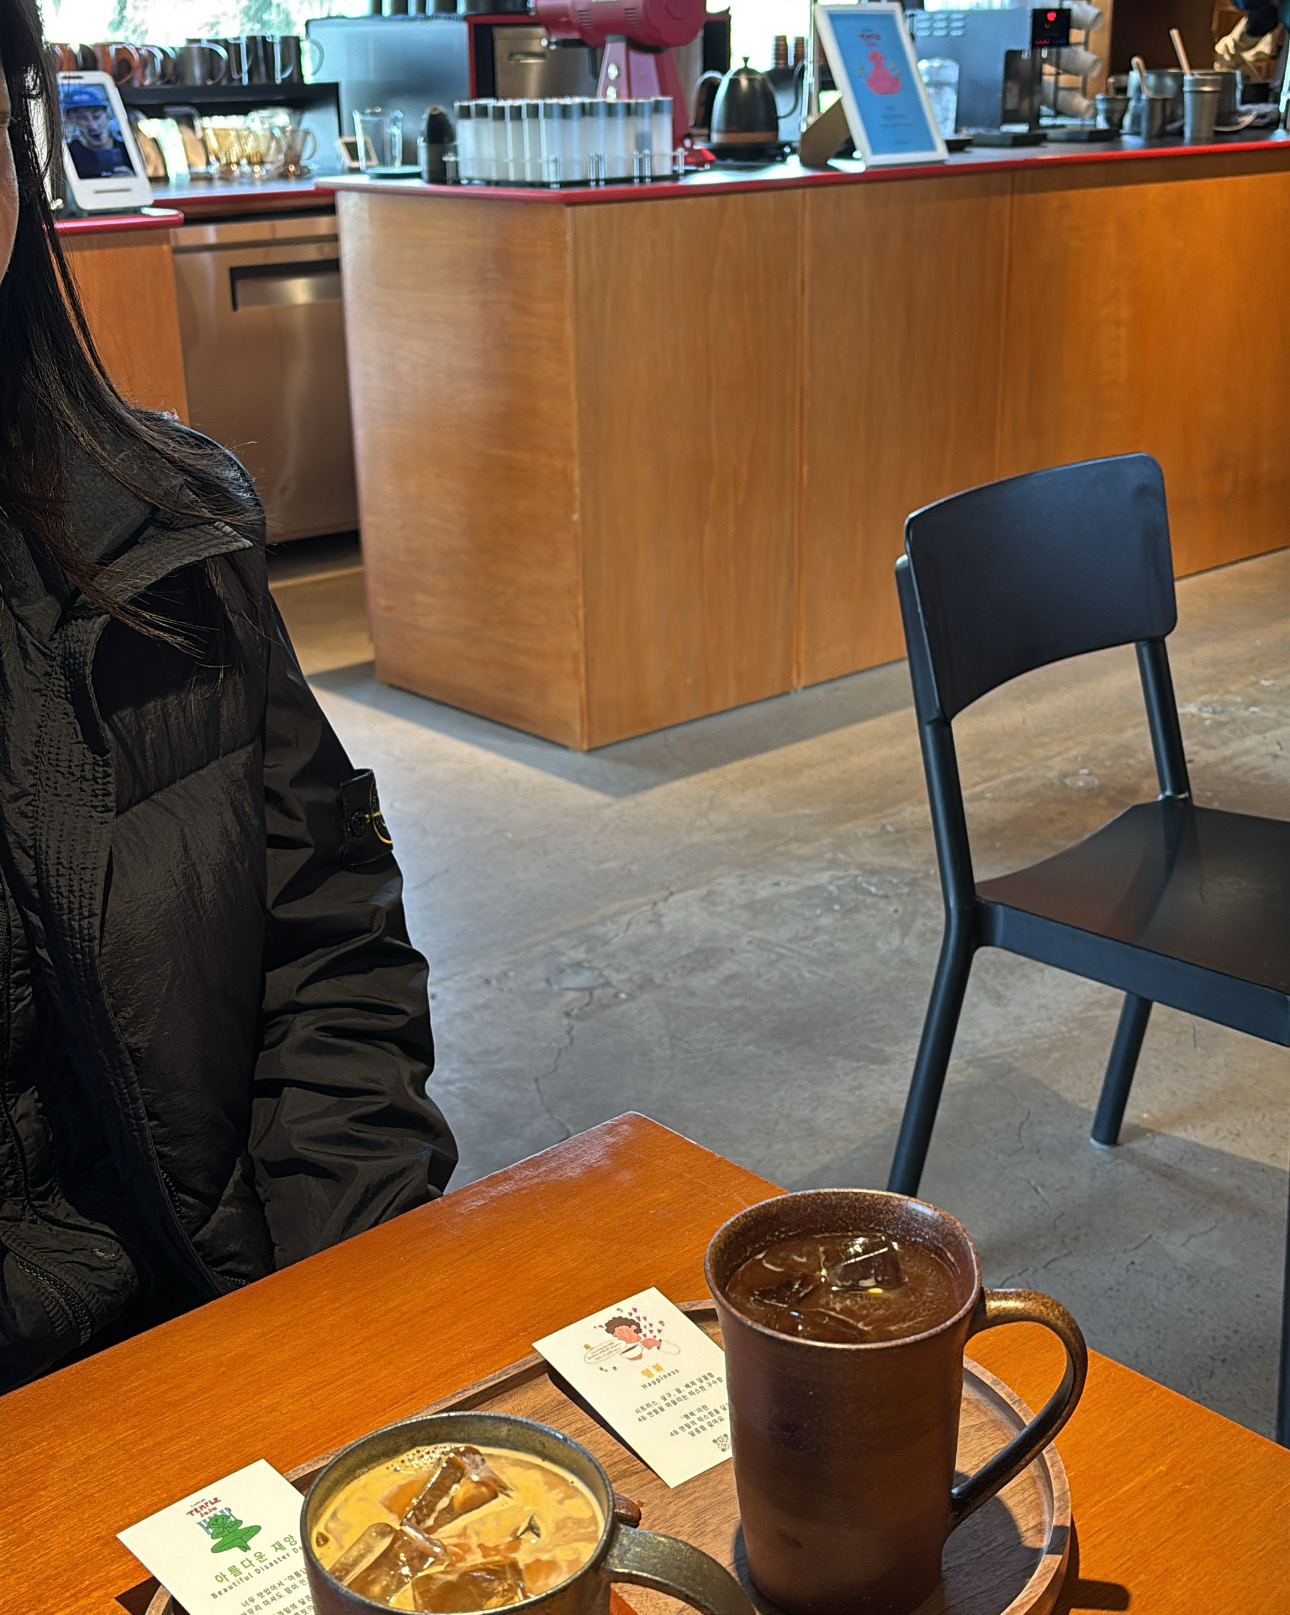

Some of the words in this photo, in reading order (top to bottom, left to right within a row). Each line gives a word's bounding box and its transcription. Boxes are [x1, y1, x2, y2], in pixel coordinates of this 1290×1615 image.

[641, 1369, 679, 1389] Happiness
[186, 1497, 221, 1516] TEMPLE
[215, 1552, 267, 1583] 아름다운
[271, 1535, 297, 1552] 재앙
[211, 1572, 253, 1599] Beautiful
[254, 1553, 290, 1574] Disaster
[241, 1597, 255, 1607] 너무
[256, 1580, 285, 1599] 맛있어서
[262, 1592, 284, 1606] 마셔도
[284, 1583, 299, 1594] 잠이
